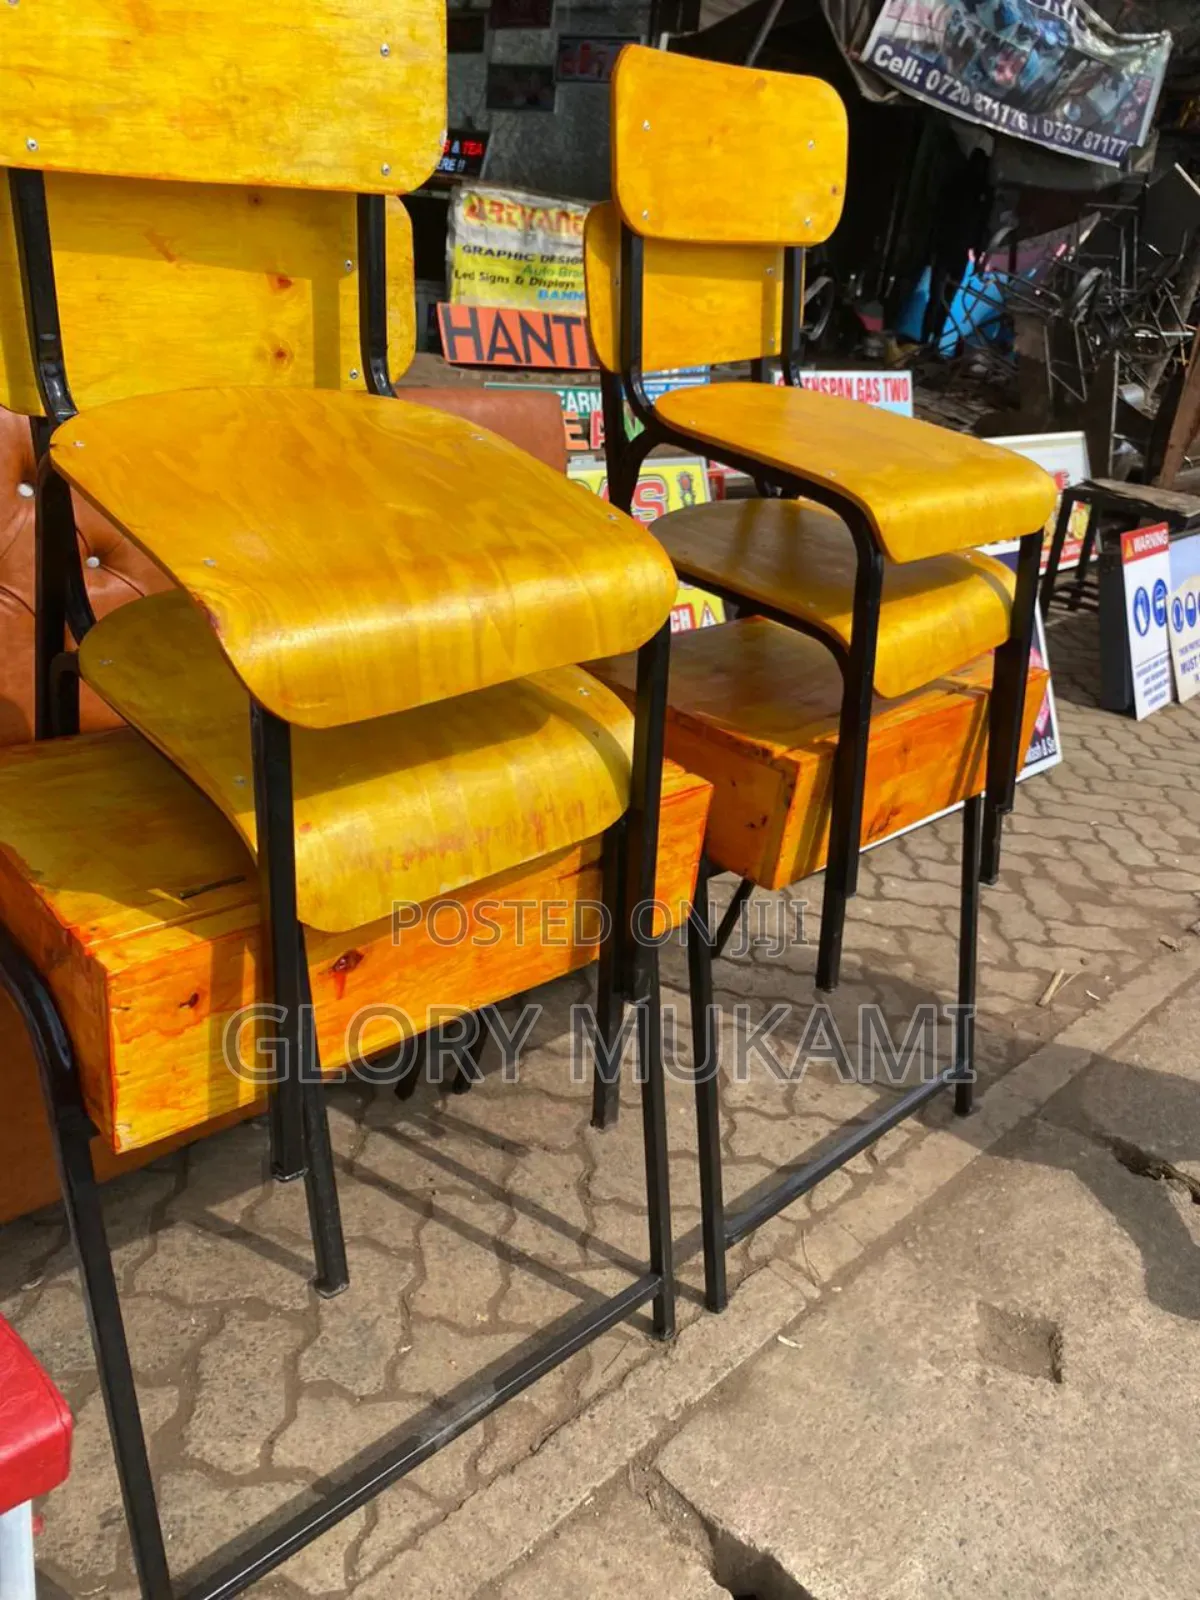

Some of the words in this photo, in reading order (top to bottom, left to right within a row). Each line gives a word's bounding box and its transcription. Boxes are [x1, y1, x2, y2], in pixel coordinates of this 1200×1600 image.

[873, 44, 923, 83] Cell:
[925, 69, 971, 106] 0720
[1043, 119, 1084, 145] 0737
[462, 140, 483, 156] TEA
[462, 244, 536, 262] GRAPHIC
[454, 269, 475, 280] Led
[479, 271, 510, 284] Signs
[529, 276, 576, 289] Displays
[856, 377, 881, 403] GAS
[884, 377, 909, 403] TWO
[1133, 528, 1169, 553] WARNING
